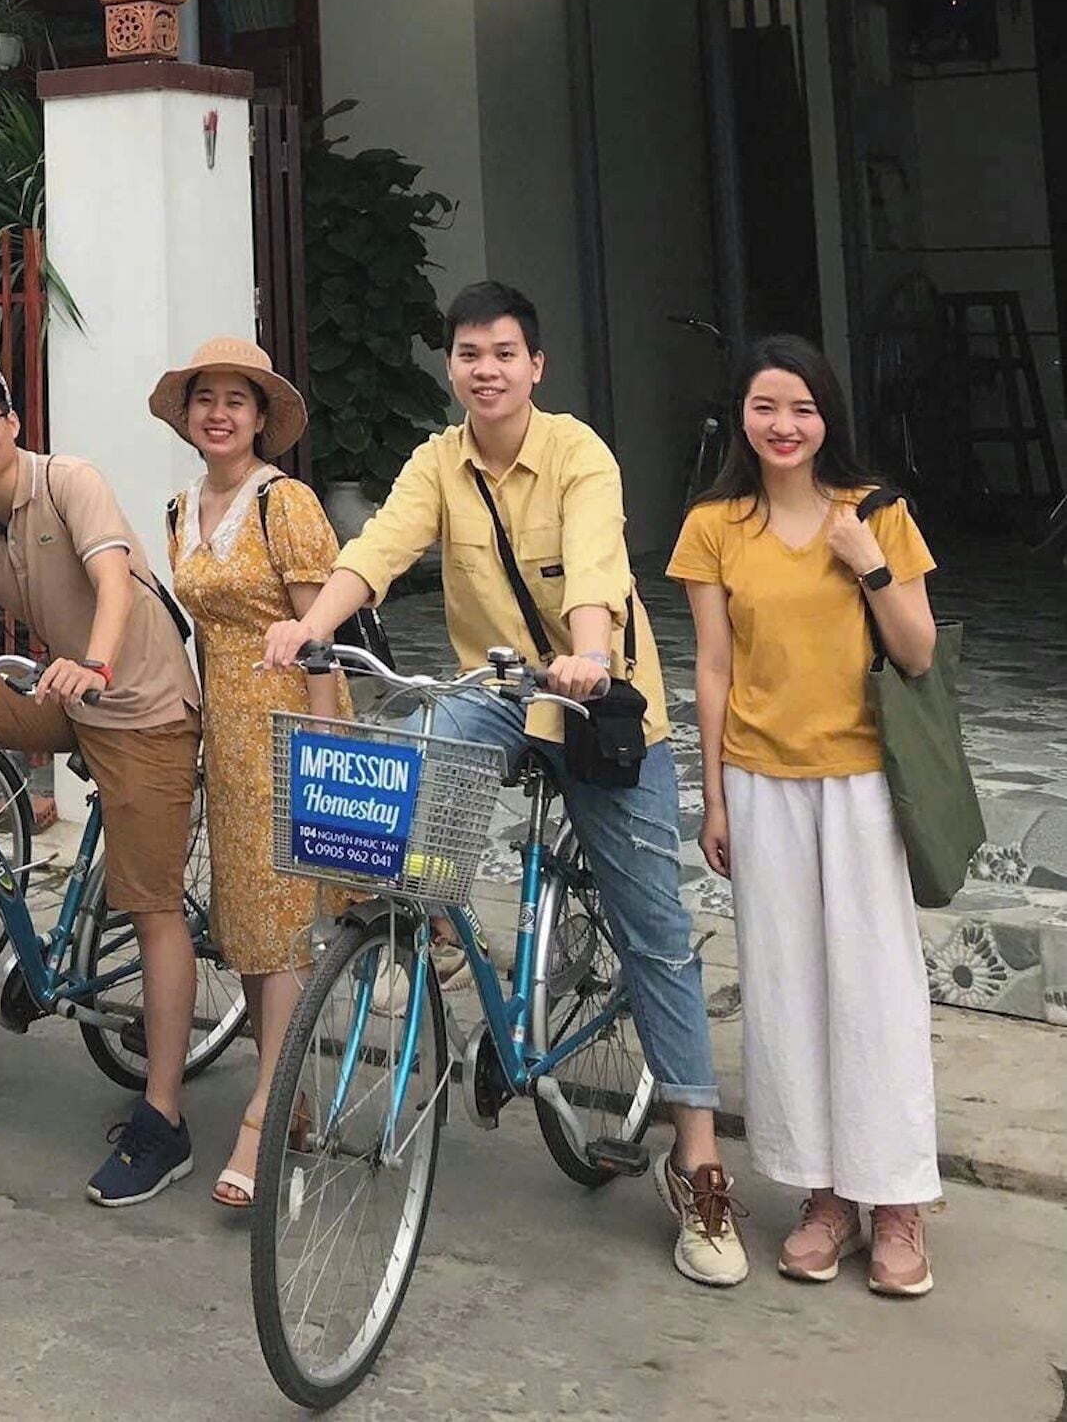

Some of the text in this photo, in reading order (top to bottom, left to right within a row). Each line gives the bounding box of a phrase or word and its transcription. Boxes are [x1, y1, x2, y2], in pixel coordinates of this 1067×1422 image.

[300, 745, 410, 793] IMPRESSION
[302, 782, 400, 834] Homestay
[299, 825, 317, 839] 104
[315, 842, 392, 868] 0905 962 041
[462, 904, 482, 935] artin
